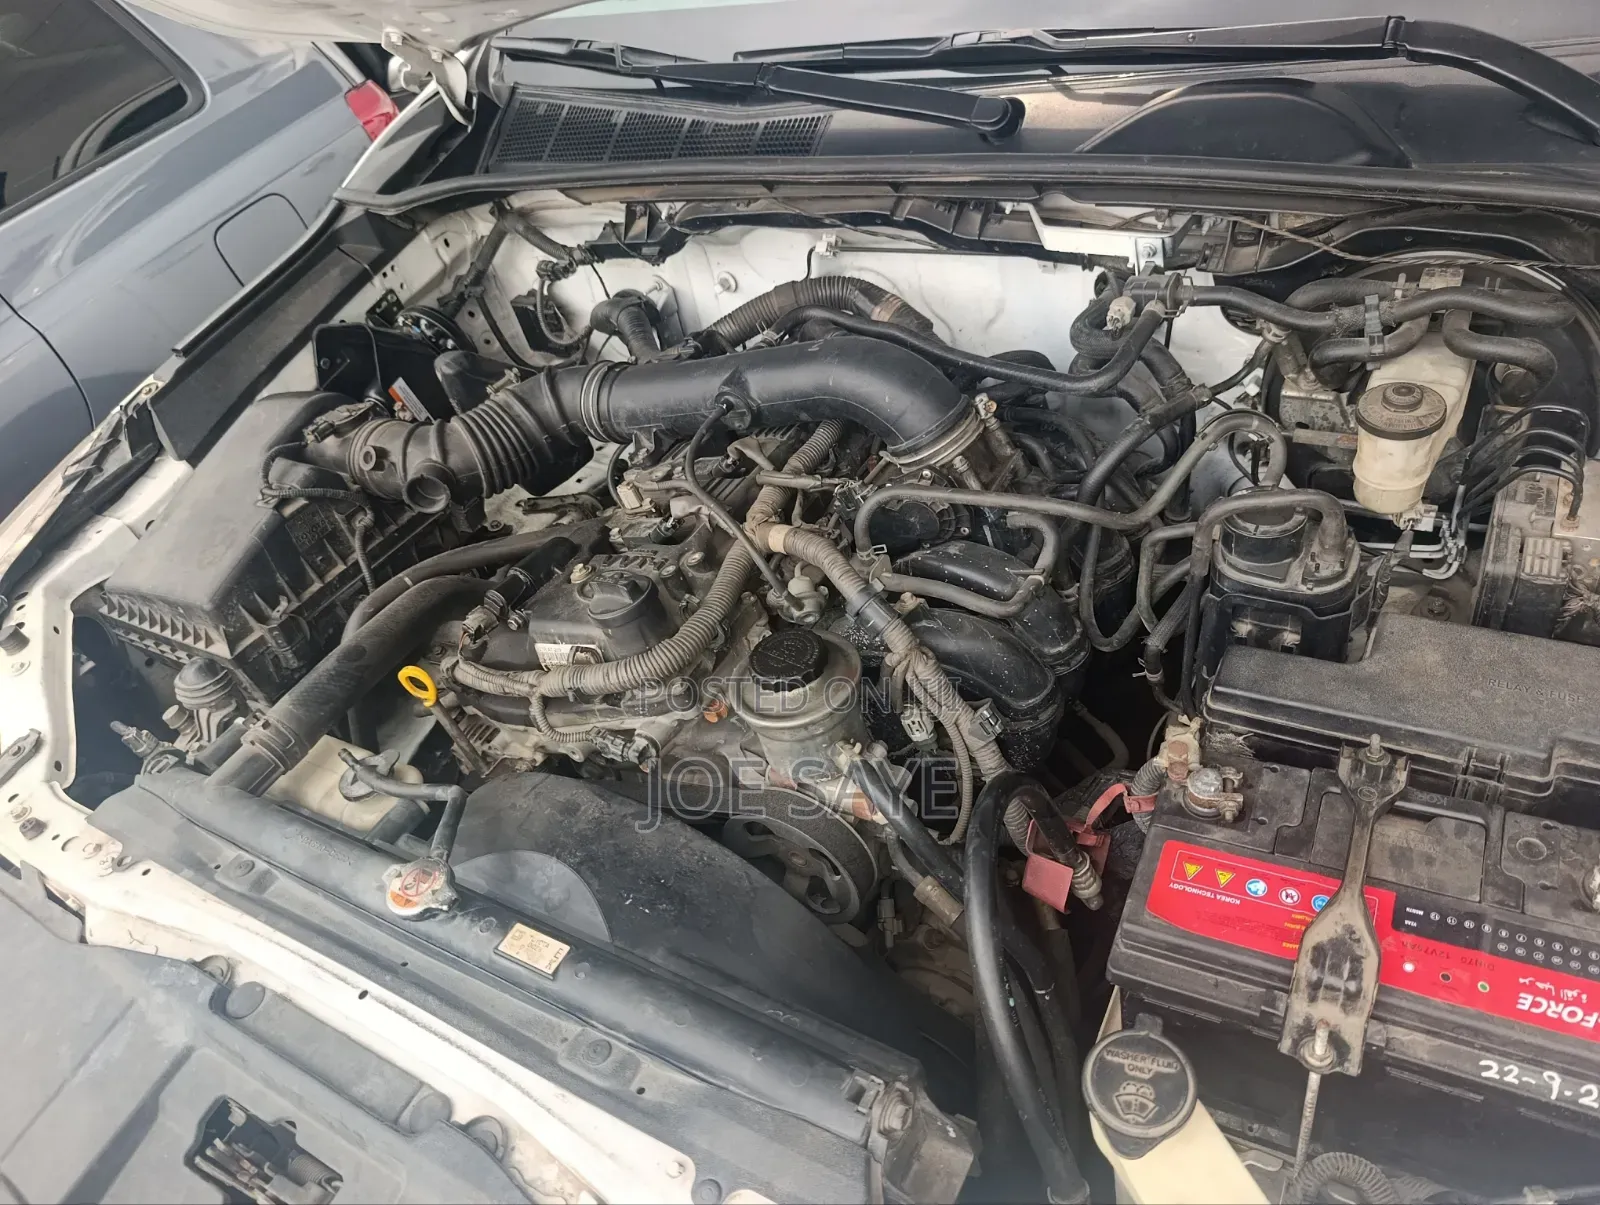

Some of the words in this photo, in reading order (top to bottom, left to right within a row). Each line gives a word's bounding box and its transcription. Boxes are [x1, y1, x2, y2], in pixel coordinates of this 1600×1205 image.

[1488, 678, 1532, 693] RELAY
[1549, 690, 1585, 702] FUSE
[1168, 882, 1215, 900] TECHNOLOGY
[1216, 892, 1241, 905] KOREA
[1105, 1048, 1147, 1063] WASHER
[1151, 1057, 1180, 1070] FLUID
[1127, 1063, 1153, 1074] ONLY
